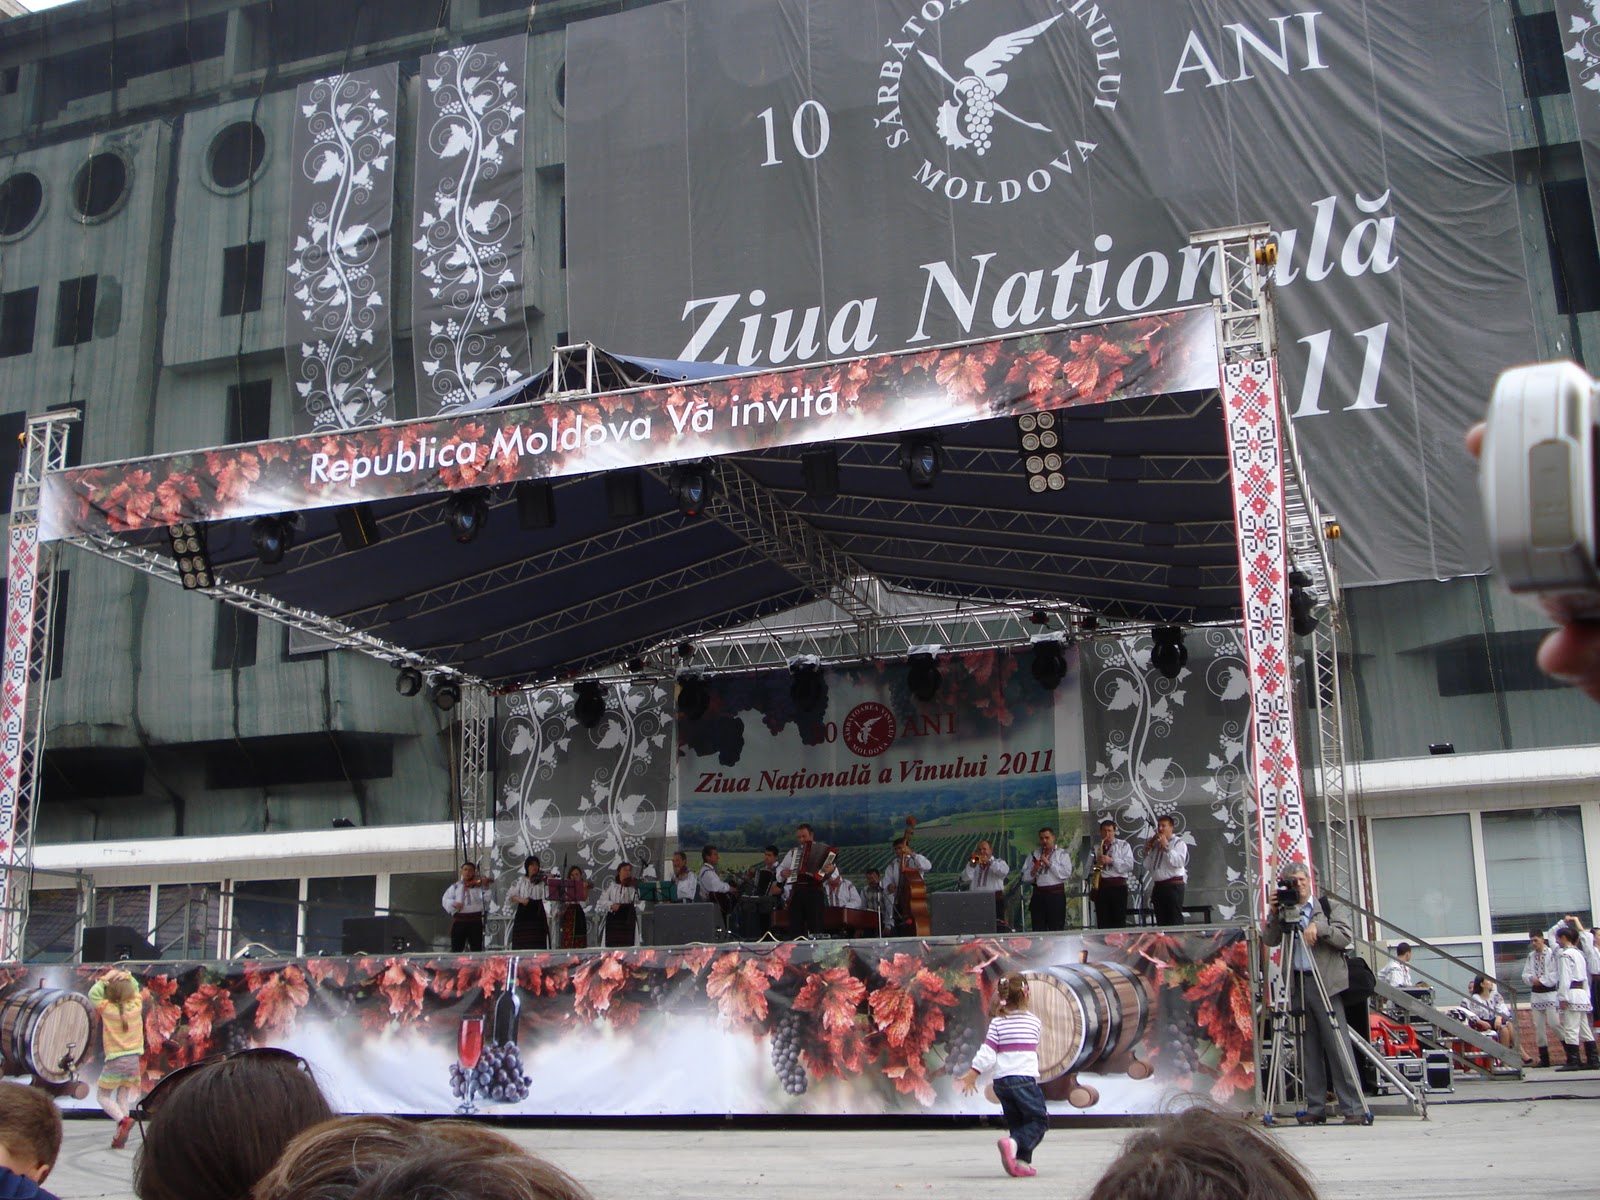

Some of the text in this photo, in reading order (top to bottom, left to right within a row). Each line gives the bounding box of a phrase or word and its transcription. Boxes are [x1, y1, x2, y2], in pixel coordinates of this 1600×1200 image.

[757, 12, 1329, 167] 10 ANI
[1057, 0, 1121, 111] INULUI
[912, 135, 1099, 204] MOLDOVA
[676, 289, 878, 367] Ziua
[310, 437, 477, 487] Republica
[490, 415, 652, 460] Moldova
[852, 742, 889, 755] MOLDOVA
[901, 712, 957, 737] ANI
[694, 771, 751, 793] Ziua
[878, 767, 892, 784] a
[900, 754, 988, 783] Vinului
[997, 749, 1053, 775] 2011
